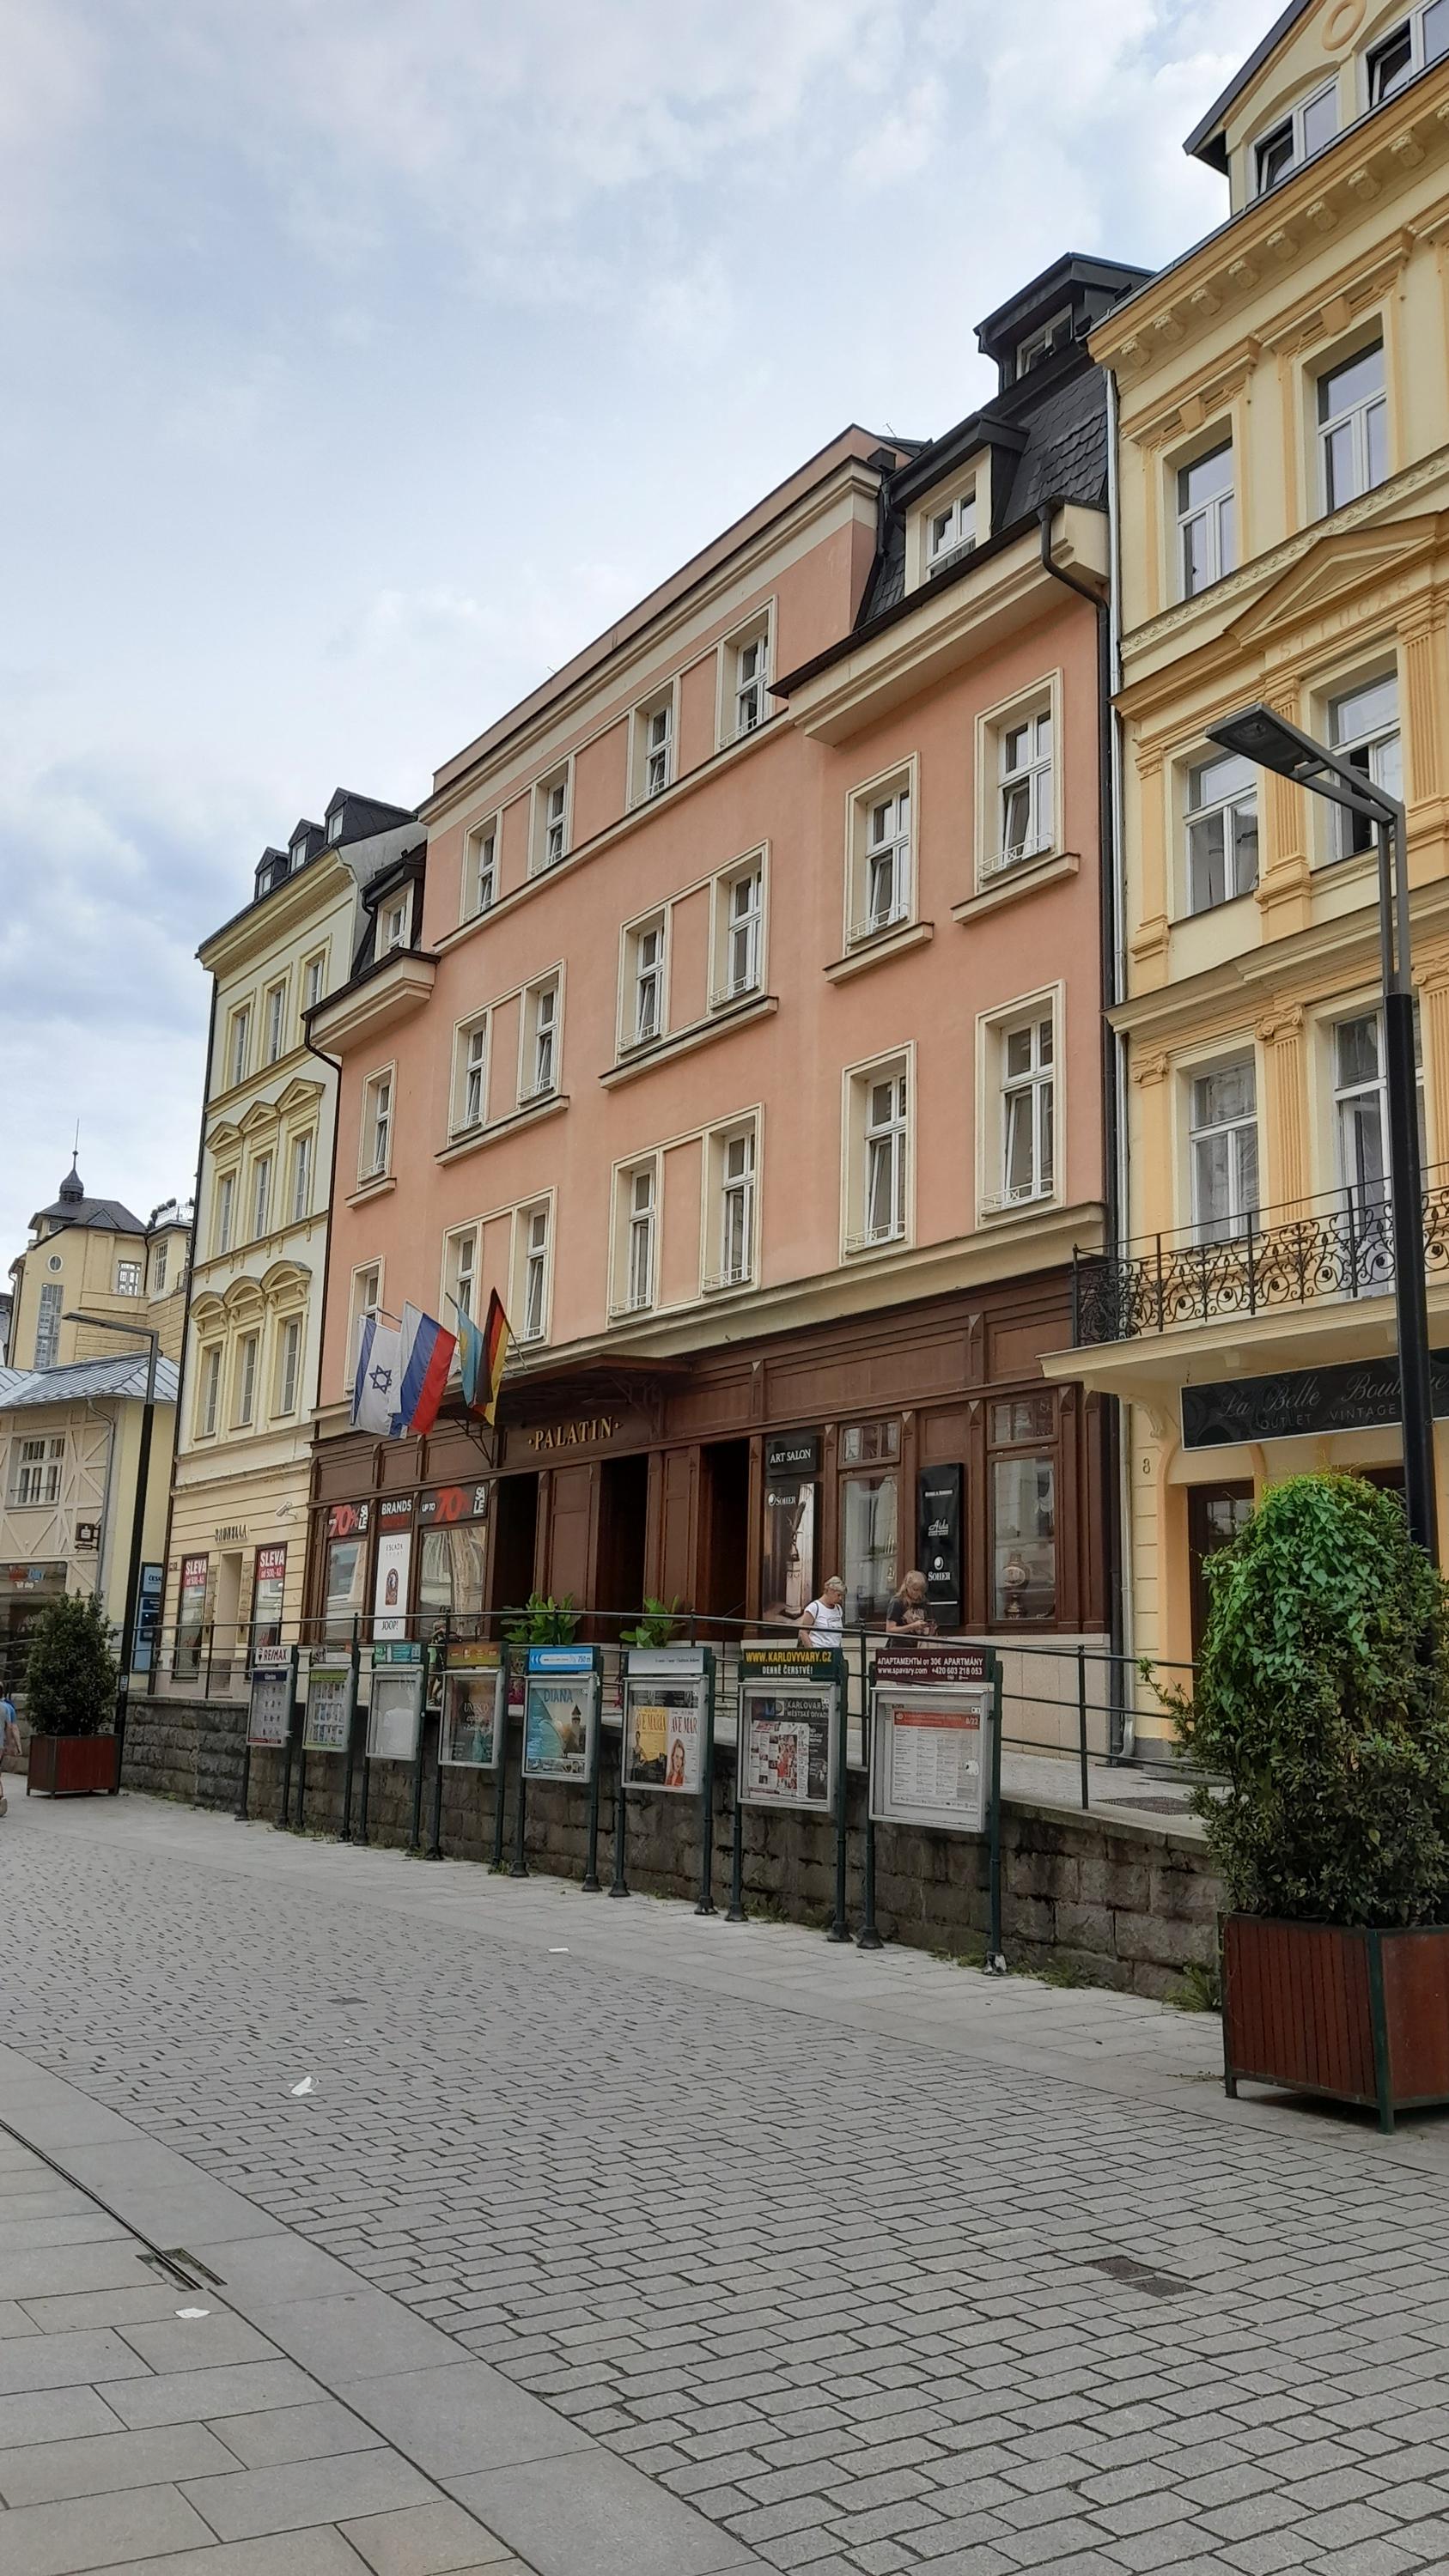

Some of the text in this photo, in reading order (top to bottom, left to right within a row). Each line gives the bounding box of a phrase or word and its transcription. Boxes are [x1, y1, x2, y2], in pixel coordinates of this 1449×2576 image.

[1217, 1390, 1250, 1417] La
[1263, 1376, 1321, 1413] Belle
[1259, 1403, 1397, 1430] OUTLET VINTAGE
[534, 1416, 612, 1451] PALATIN
[770, 1448, 812, 1464] ART SALON
[1142, 1457, 1151, 1475] 8
[381, 1499, 412, 1515] BRANDS
[259, 1550, 284, 1567] SLEVA
[185, 1558, 207, 1576] SLEVA
[264, 1648, 288, 1662] RE/MAX
[746, 1651, 832, 1662] WWW.KARLOVYVARY.CZ
[943, 1656, 983, 1666] APARTMÁNY
[762, 1664, 782, 1674] DENNĚ
[877, 1667, 928, 1675] www.spavary.com
[544, 1688, 574, 1703] DIANA
[671, 1717, 682, 1733] AVE
